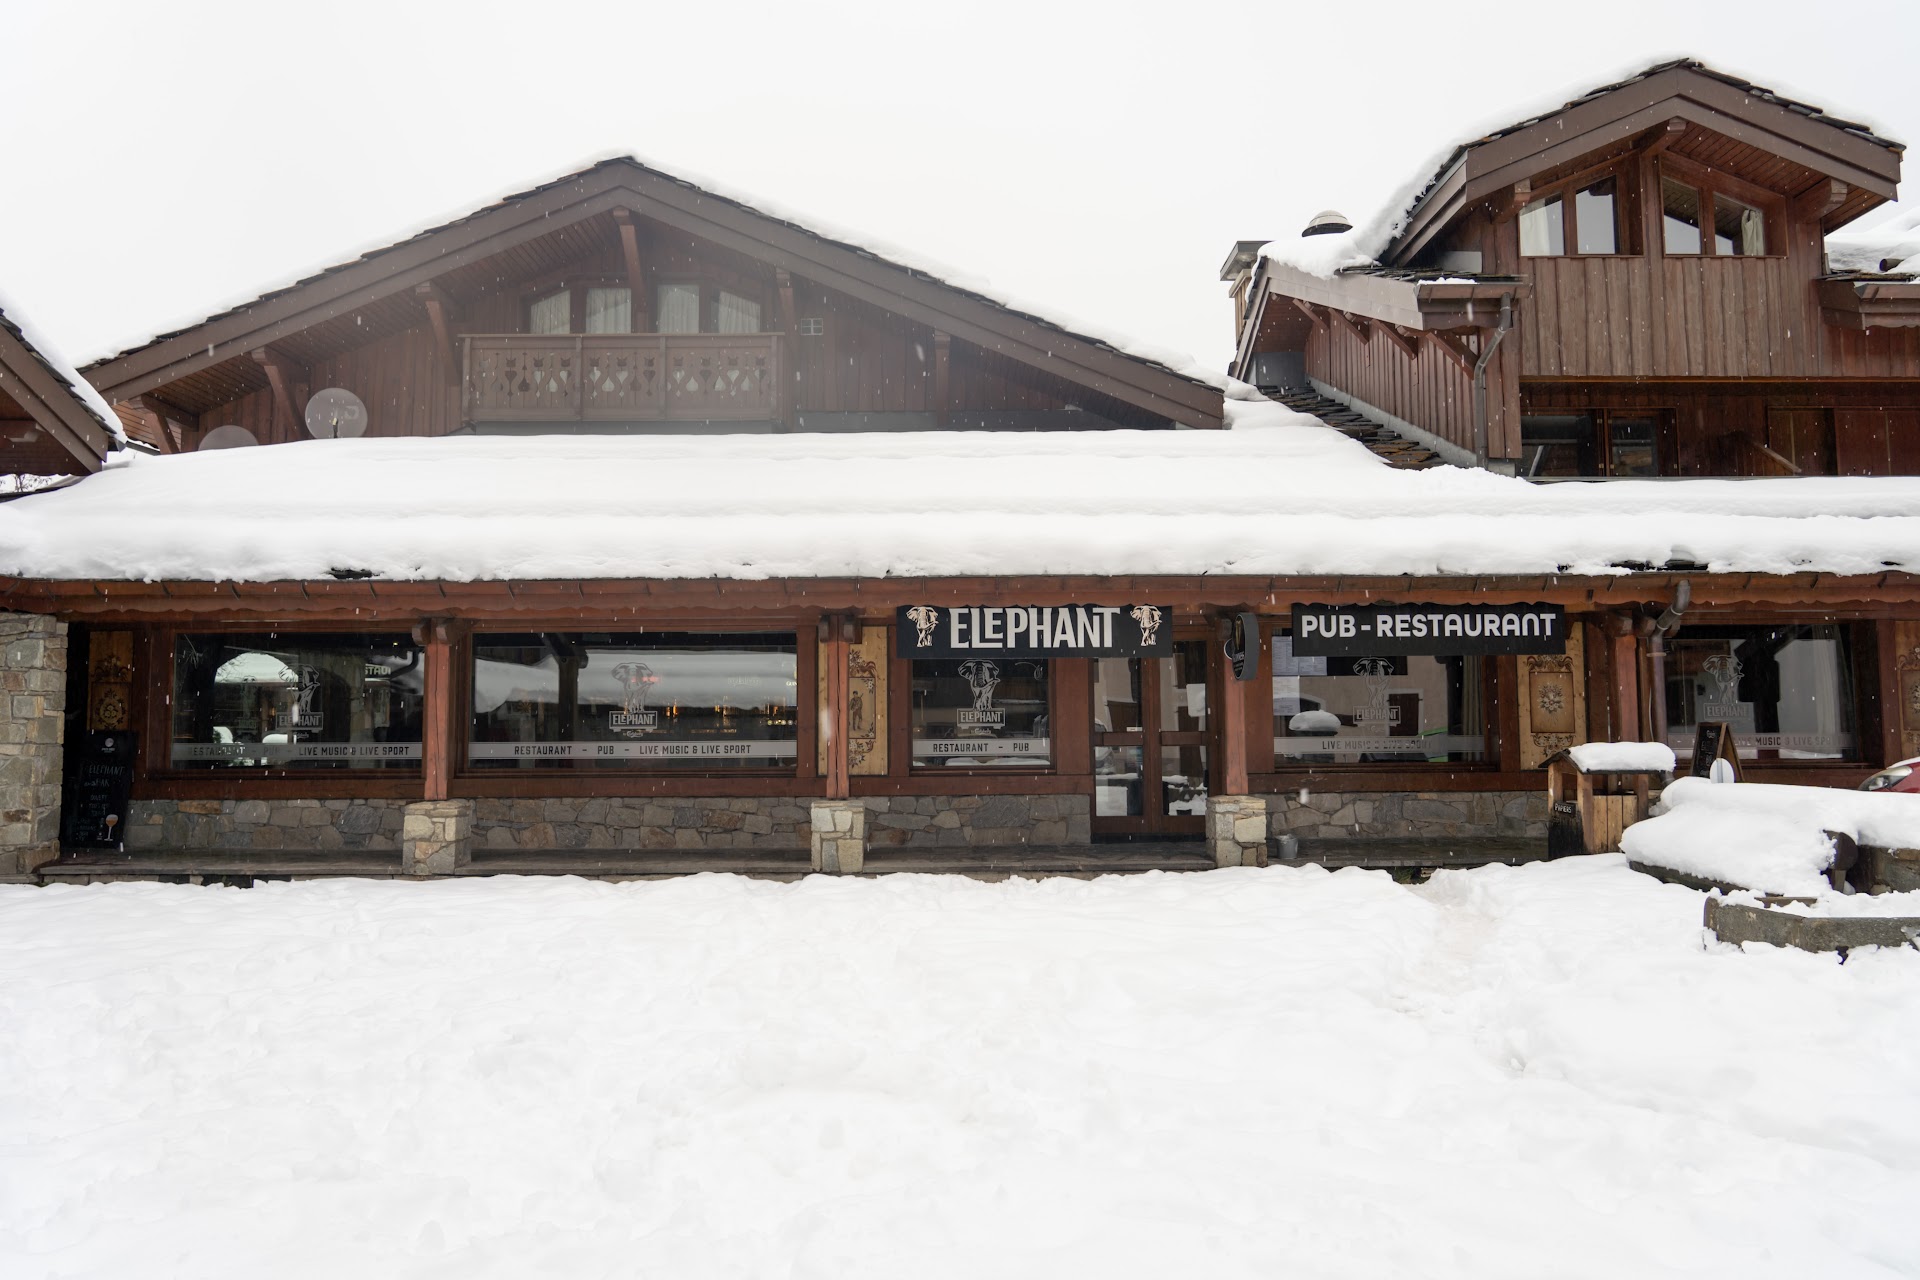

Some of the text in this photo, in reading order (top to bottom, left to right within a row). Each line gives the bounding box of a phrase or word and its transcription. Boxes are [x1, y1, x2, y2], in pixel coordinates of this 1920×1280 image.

[949, 607, 1121, 649] ELEPHANT
[1356, 708, 1399, 720] ELEPHANT
[1707, 705, 1747, 717] ELEPHANT
[612, 714, 655, 725] ELEPHANT
[960, 711, 1003, 723] ELEPHANT
[1322, 740, 1341, 750] LIVE
[1344, 740, 1371, 750] MUSIC
[1756, 736, 1781, 746] MUSIC
[1793, 736, 1812, 746] LIVE
[298, 746, 318, 756] LIVE
[321, 746, 348, 756] MUSIC
[359, 746, 379, 756] LIVE
[382, 746, 410, 756] SPORT
[514, 745, 573, 755] RESTAURANT
[597, 745, 614, 755] PUB
[639, 745, 659, 755] LIVE
[662, 745, 689, 754] MUSIC
[692, 745, 698, 754] &
[701, 745, 721, 754] LIVE
[724, 744, 751, 754] SPORT
[932, 743, 989, 753] RESTAURANT
[1013, 742, 1030, 752] PUB
